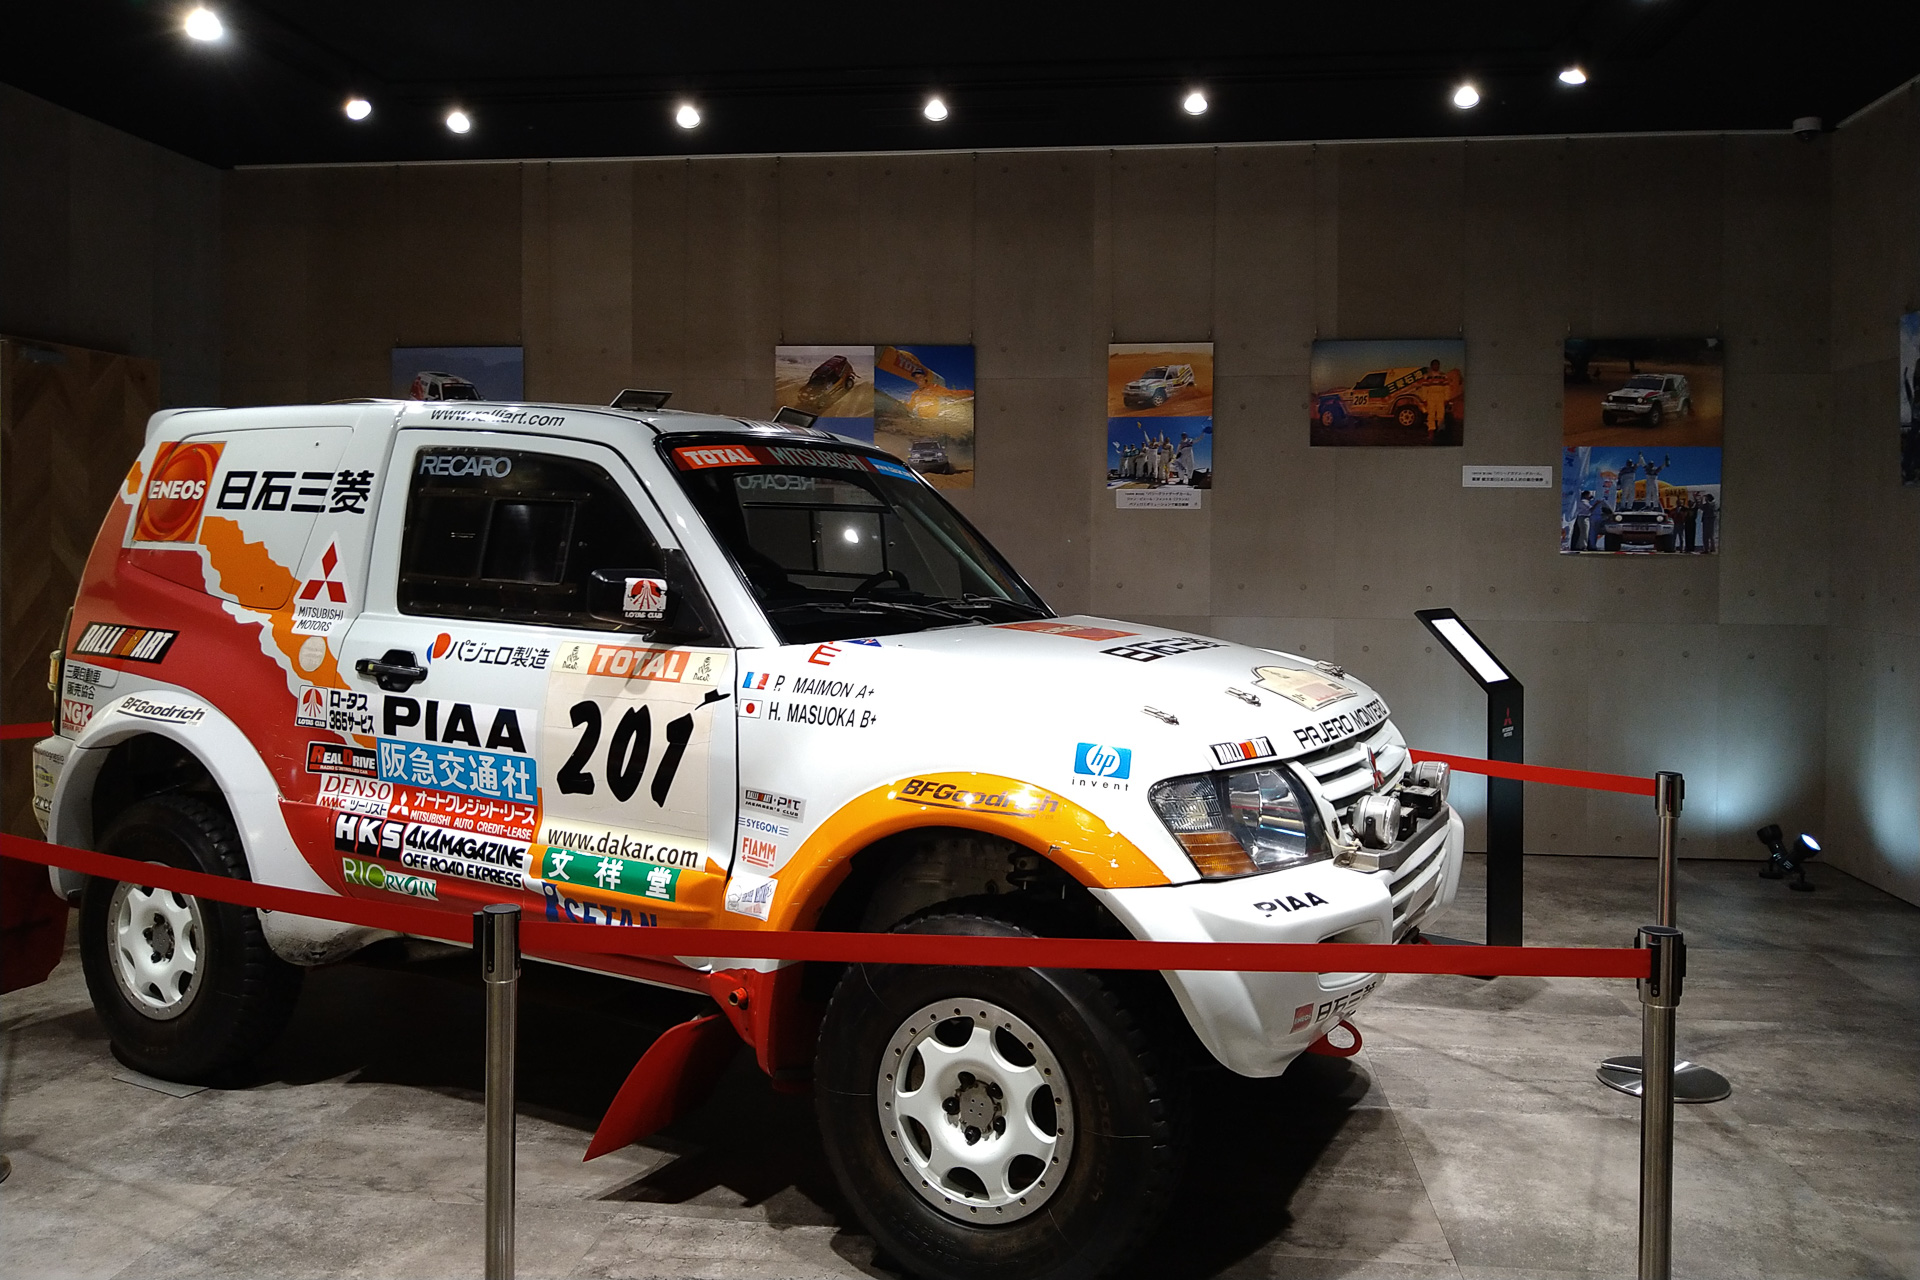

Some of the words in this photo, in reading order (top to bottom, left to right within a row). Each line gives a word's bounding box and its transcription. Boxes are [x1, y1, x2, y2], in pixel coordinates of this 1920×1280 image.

[1354, 396, 1368, 405] 205
[419, 455, 512, 478] RECARO
[683, 448, 758, 467] TOTAL
[766, 446, 868, 472] MITSUBISHI
[147, 480, 206, 500] ENEOS
[216, 470, 375, 514] 日石三菱
[297, 618, 333, 632] MOTORS
[298, 606, 344, 621] MITSUBISHI
[445, 639, 550, 670] パジェロ製造
[596, 648, 682, 680] TOTAL
[330, 690, 368, 712] ロータス
[793, 678, 854, 698] MAIMON
[855, 683, 875, 699] A+
[63, 700, 92, 726] NGK
[121, 697, 207, 721] BFGoodrich
[329, 709, 375, 735] 365サービス
[768, 705, 781, 720] H.
[787, 705, 855, 727] MASUOKA
[859, 710, 877, 728] B+
[383, 695, 527, 753] PIAA
[1293, 714, 1354, 750] PAJERO
[1350, 698, 1389, 731] MONTERO
[557, 700, 694, 808] 201
[1091, 745, 1116, 776] hp
[380, 742, 534, 802] 阪急交通社
[1072, 777, 1129, 792] invent
[323, 775, 391, 800] DENSO
[319, 796, 346, 809] MMC
[350, 800, 387, 816] ツーリスト
[414, 791, 536, 826] オートクレジット・リース
[745, 801, 780, 812] MEMBER'S
[783, 809, 799, 817] CLUB
[336, 814, 404, 849] HKS
[410, 810, 451, 827] MITSUBISHI
[453, 817, 473, 830] AUTO
[476, 821, 533, 840] CREDIT-LEASE
[746, 819, 779, 834] SYEGON
[548, 827, 699, 869] www.dakar.com
[742, 836, 777, 862] FIAMM
[403, 853, 428, 869] OFF
[430, 856, 464, 876] ROAD
[466, 864, 523, 888] EXPRESS
[1253, 892, 1329, 918] PIAA
